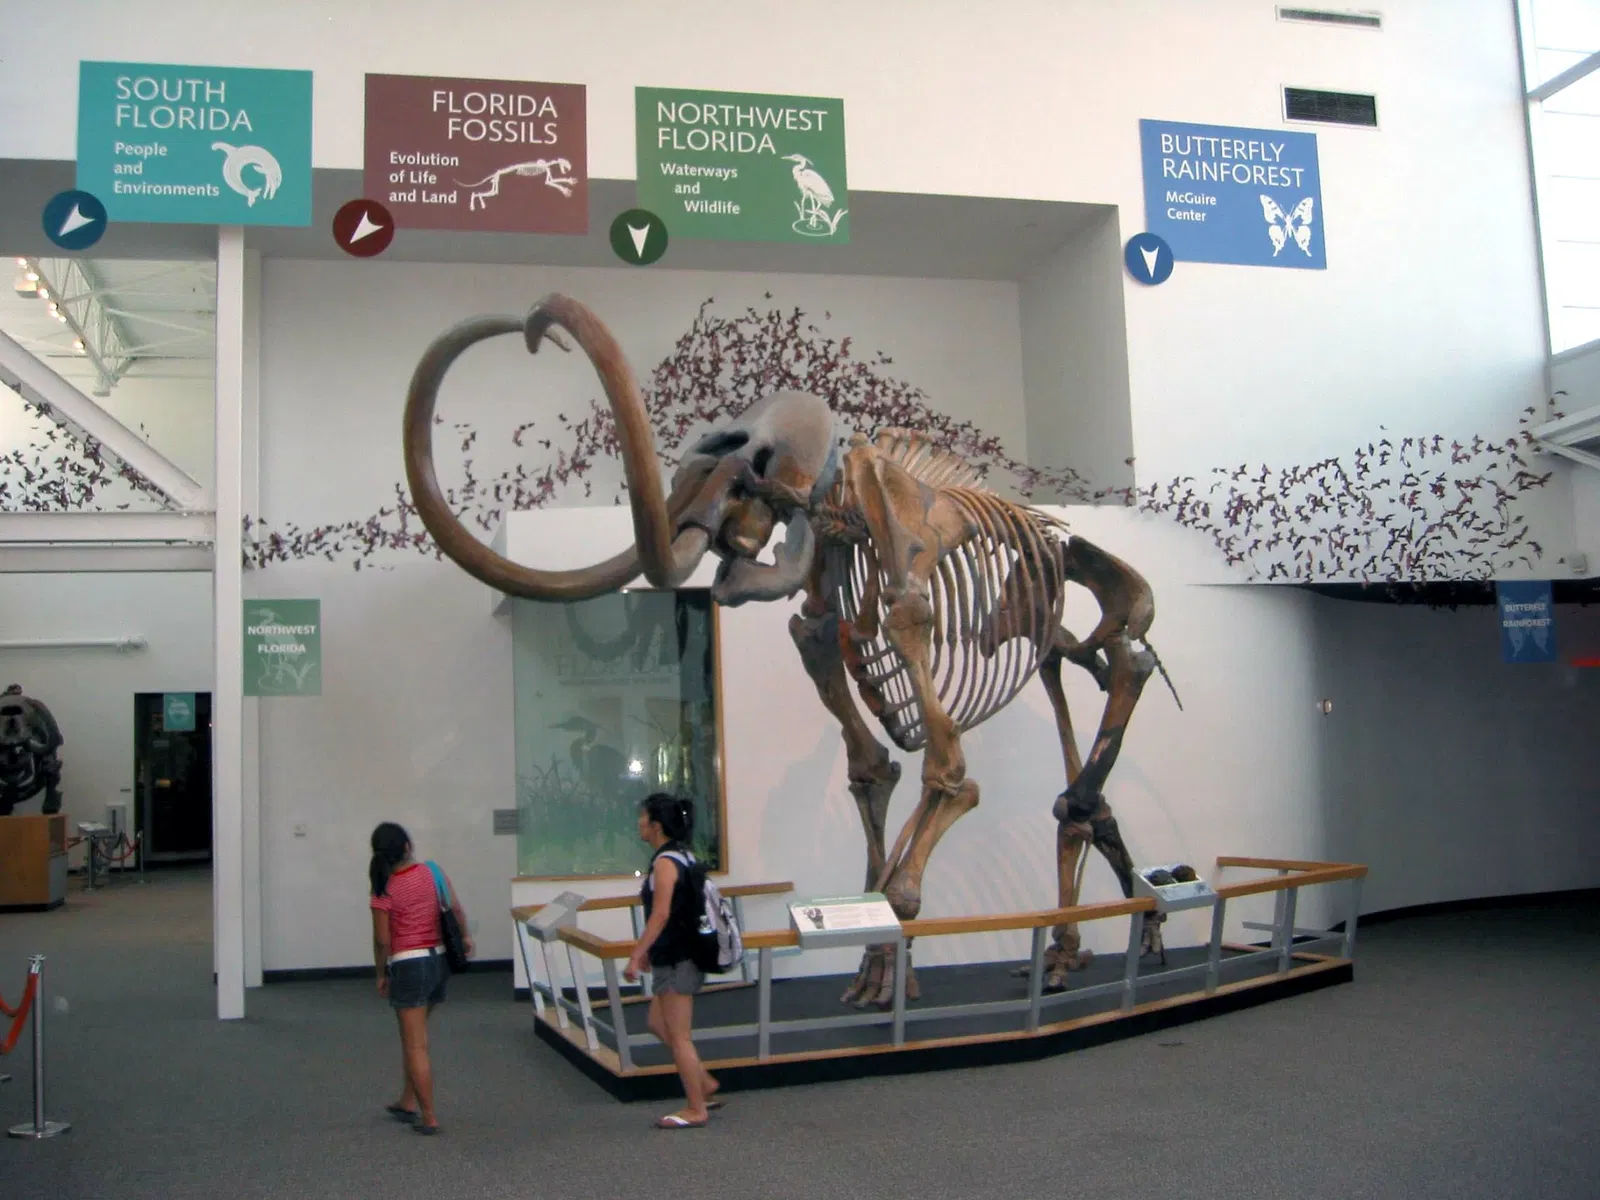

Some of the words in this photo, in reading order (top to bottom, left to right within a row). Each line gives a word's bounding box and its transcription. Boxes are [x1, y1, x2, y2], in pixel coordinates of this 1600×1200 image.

[115, 76, 226, 103] SOUTH
[432, 90, 558, 118] FLORIDA
[115, 105, 253, 132] FLORIDA
[657, 101, 828, 131] NORTHWEST
[447, 117, 558, 145] FOSSILS
[658, 128, 777, 154] FLORIDA
[1161, 134, 1284, 161] BUTTERFLY
[114, 141, 168, 159] People
[390, 151, 460, 167] Evolution
[113, 161, 143, 175] and
[659, 162, 738, 182] Waterways
[1162, 158, 1304, 187] RAINFOREST
[389, 169, 406, 183] of
[410, 170, 438, 185] Life
[113, 180, 220, 197] Environments
[389, 188, 418, 203] and
[422, 189, 458, 204] Land
[674, 181, 702, 195] and
[1165, 190, 1217, 206] McGuire
[683, 199, 741, 215] Wildlife
[1166, 207, 1207, 222] Center
[247, 625, 316, 635] NORTHWEST
[257, 643, 306, 653] FLORIDA
